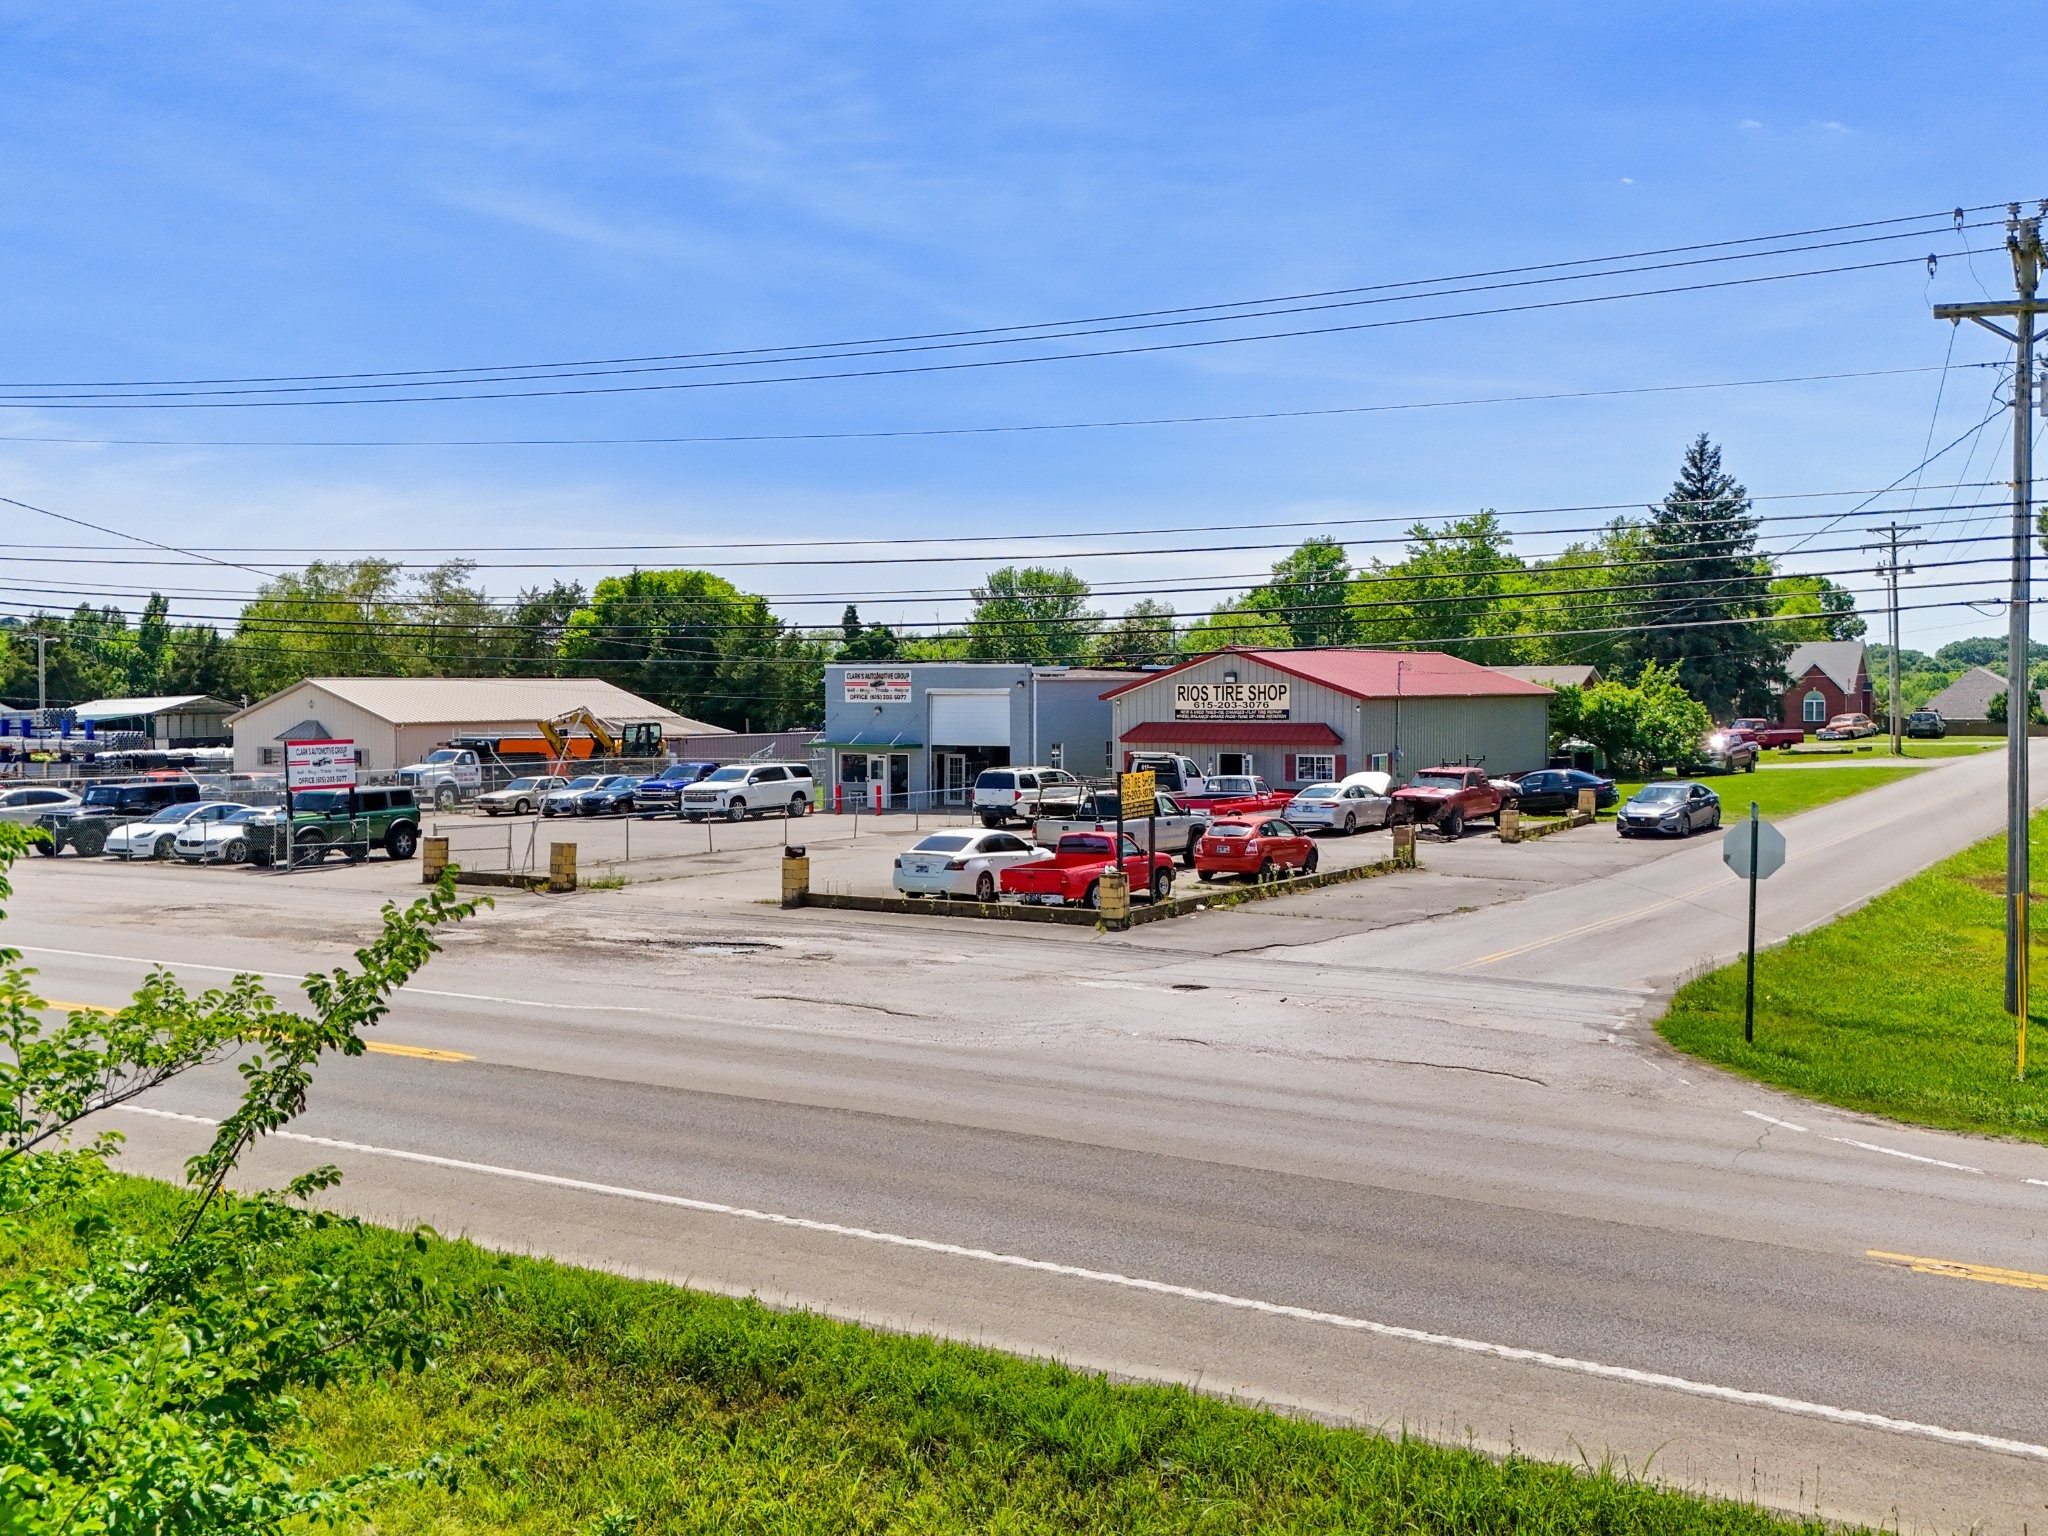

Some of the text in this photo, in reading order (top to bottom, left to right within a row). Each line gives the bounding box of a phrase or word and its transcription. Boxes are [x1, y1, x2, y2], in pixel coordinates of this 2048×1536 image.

[1177, 685, 1287, 701] RIOS TIRE SHOP
[312, 747, 334, 755] AUTOMOTIVE
[1142, 775, 1154, 787] SHOP
